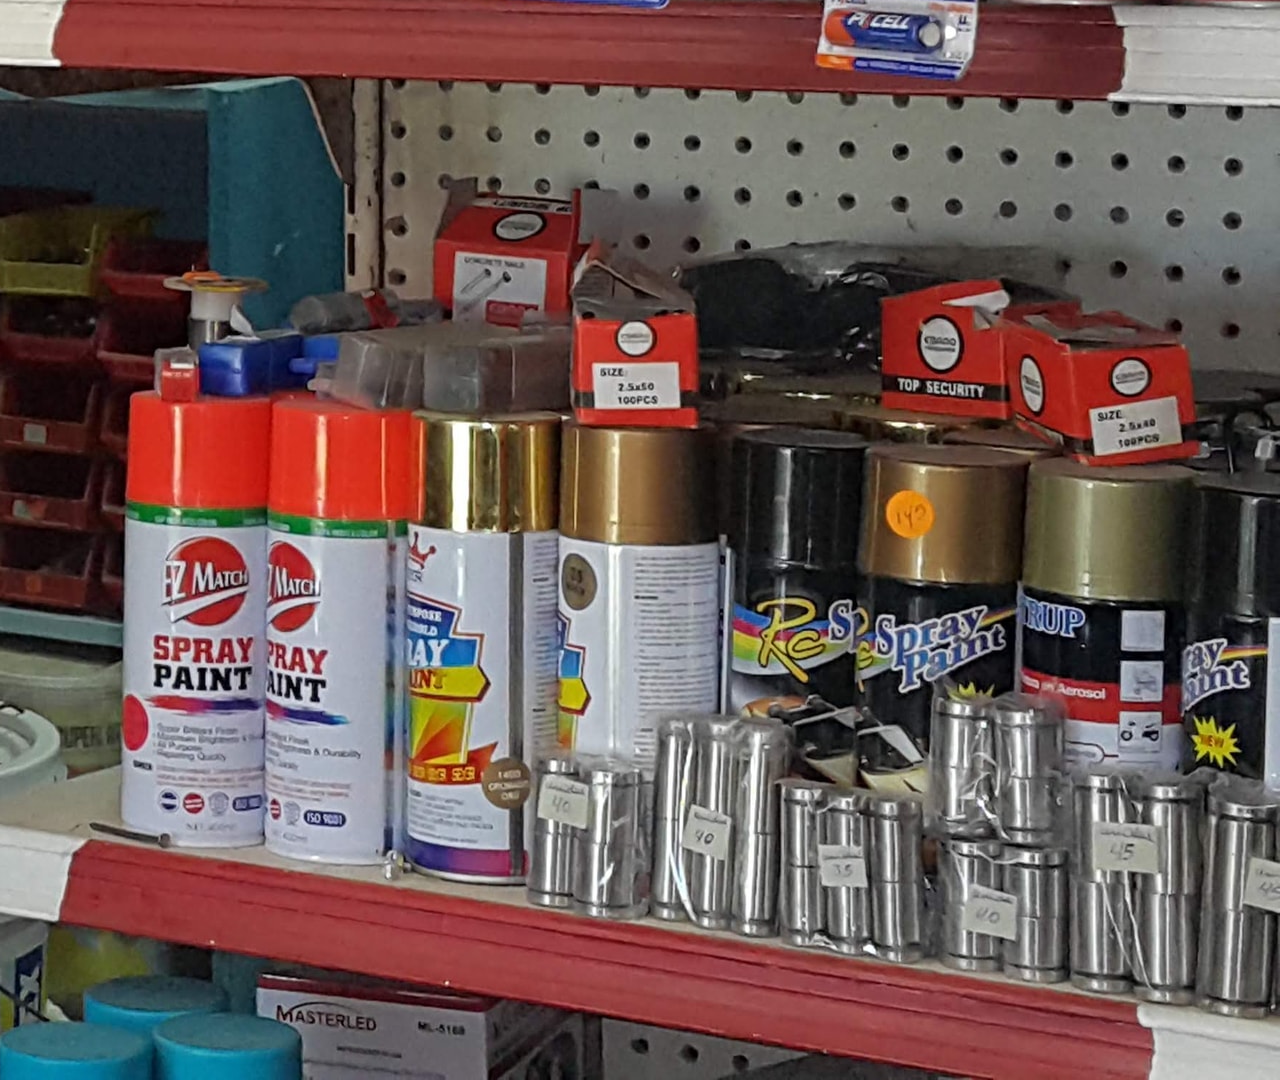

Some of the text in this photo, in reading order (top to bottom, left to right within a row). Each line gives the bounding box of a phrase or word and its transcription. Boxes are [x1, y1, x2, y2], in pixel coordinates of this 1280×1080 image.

[897, 378, 985, 399] TOP SECURITY
[153, 634, 254, 664] SPRAY
[875, 604, 988, 669] Spray
[267, 639, 329, 675] PRAY
[891, 622, 1007, 694] Paint
[153, 664, 253, 691] PAINT
[267, 670, 327, 700] AINT
[1056, 683, 1107, 700] Aerosol
[276, 1004, 377, 1032] MASTERLED
